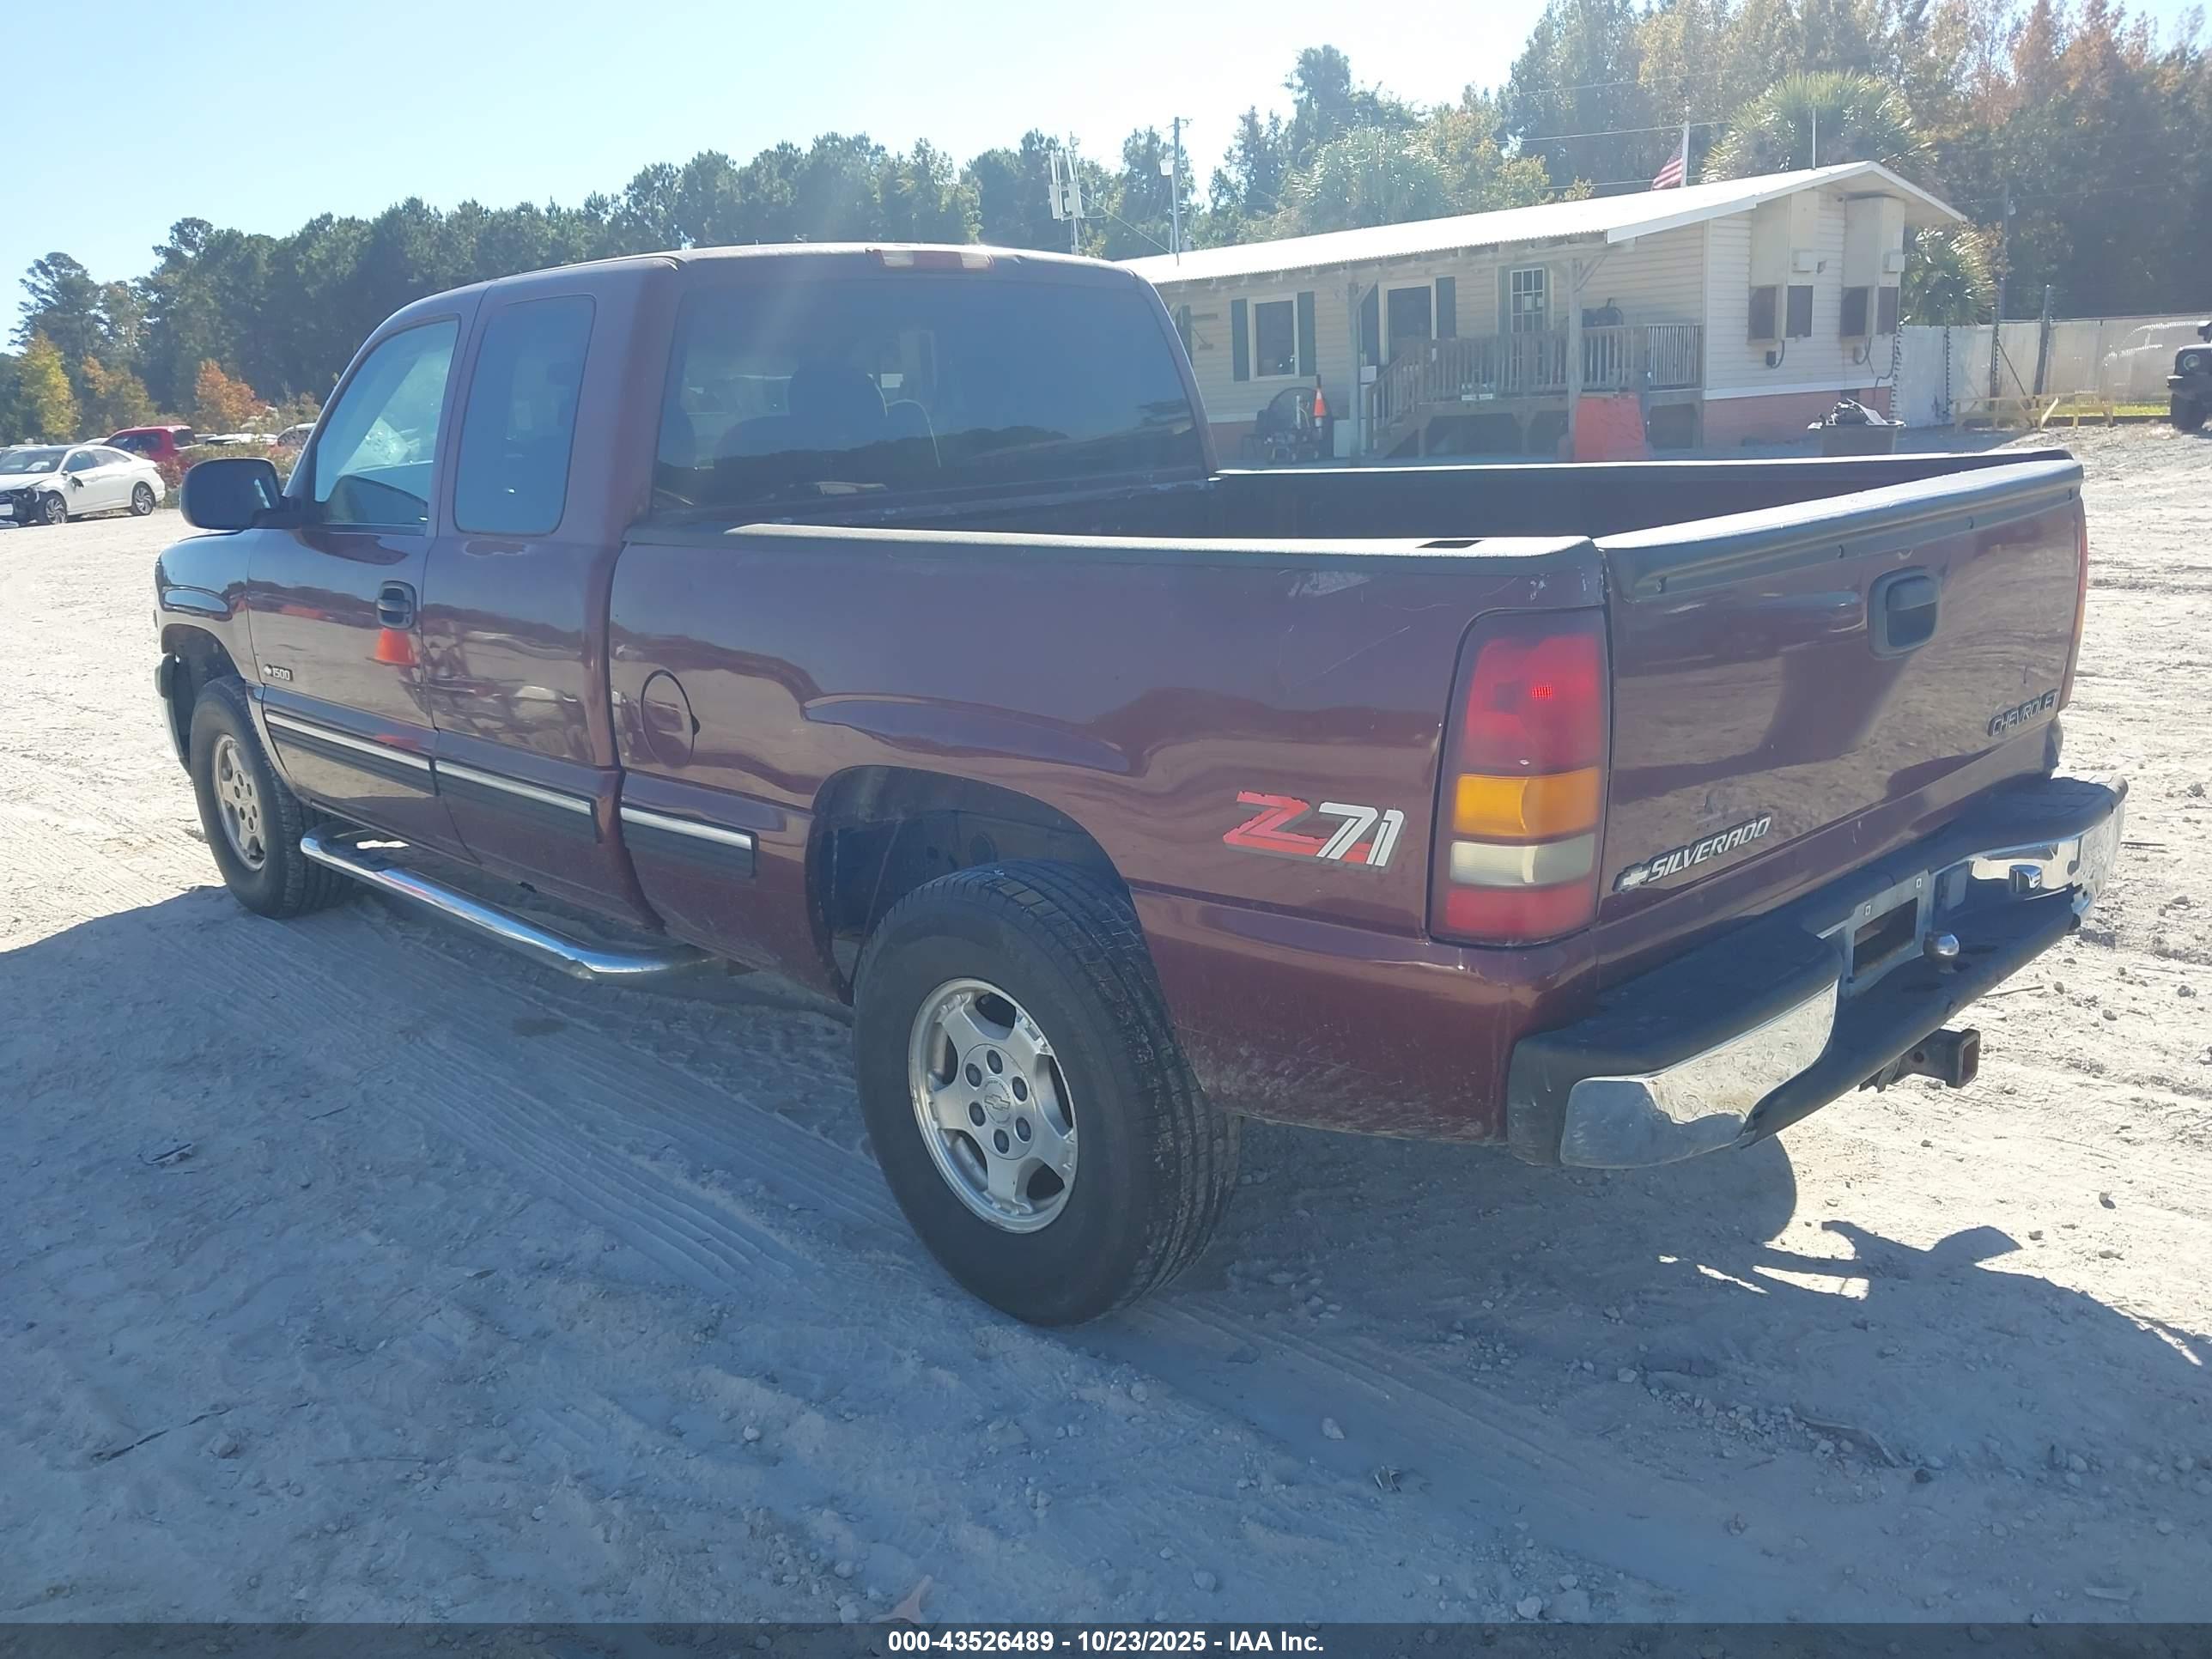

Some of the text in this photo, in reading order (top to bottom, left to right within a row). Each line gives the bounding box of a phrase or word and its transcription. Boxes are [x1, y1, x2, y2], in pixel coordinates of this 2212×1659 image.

[272, 667, 290, 680] 1500
[1992, 692, 2059, 736] CHEVROLET
[1223, 790, 1405, 867] Z71
[1648, 816, 1771, 883] SILVERADO
